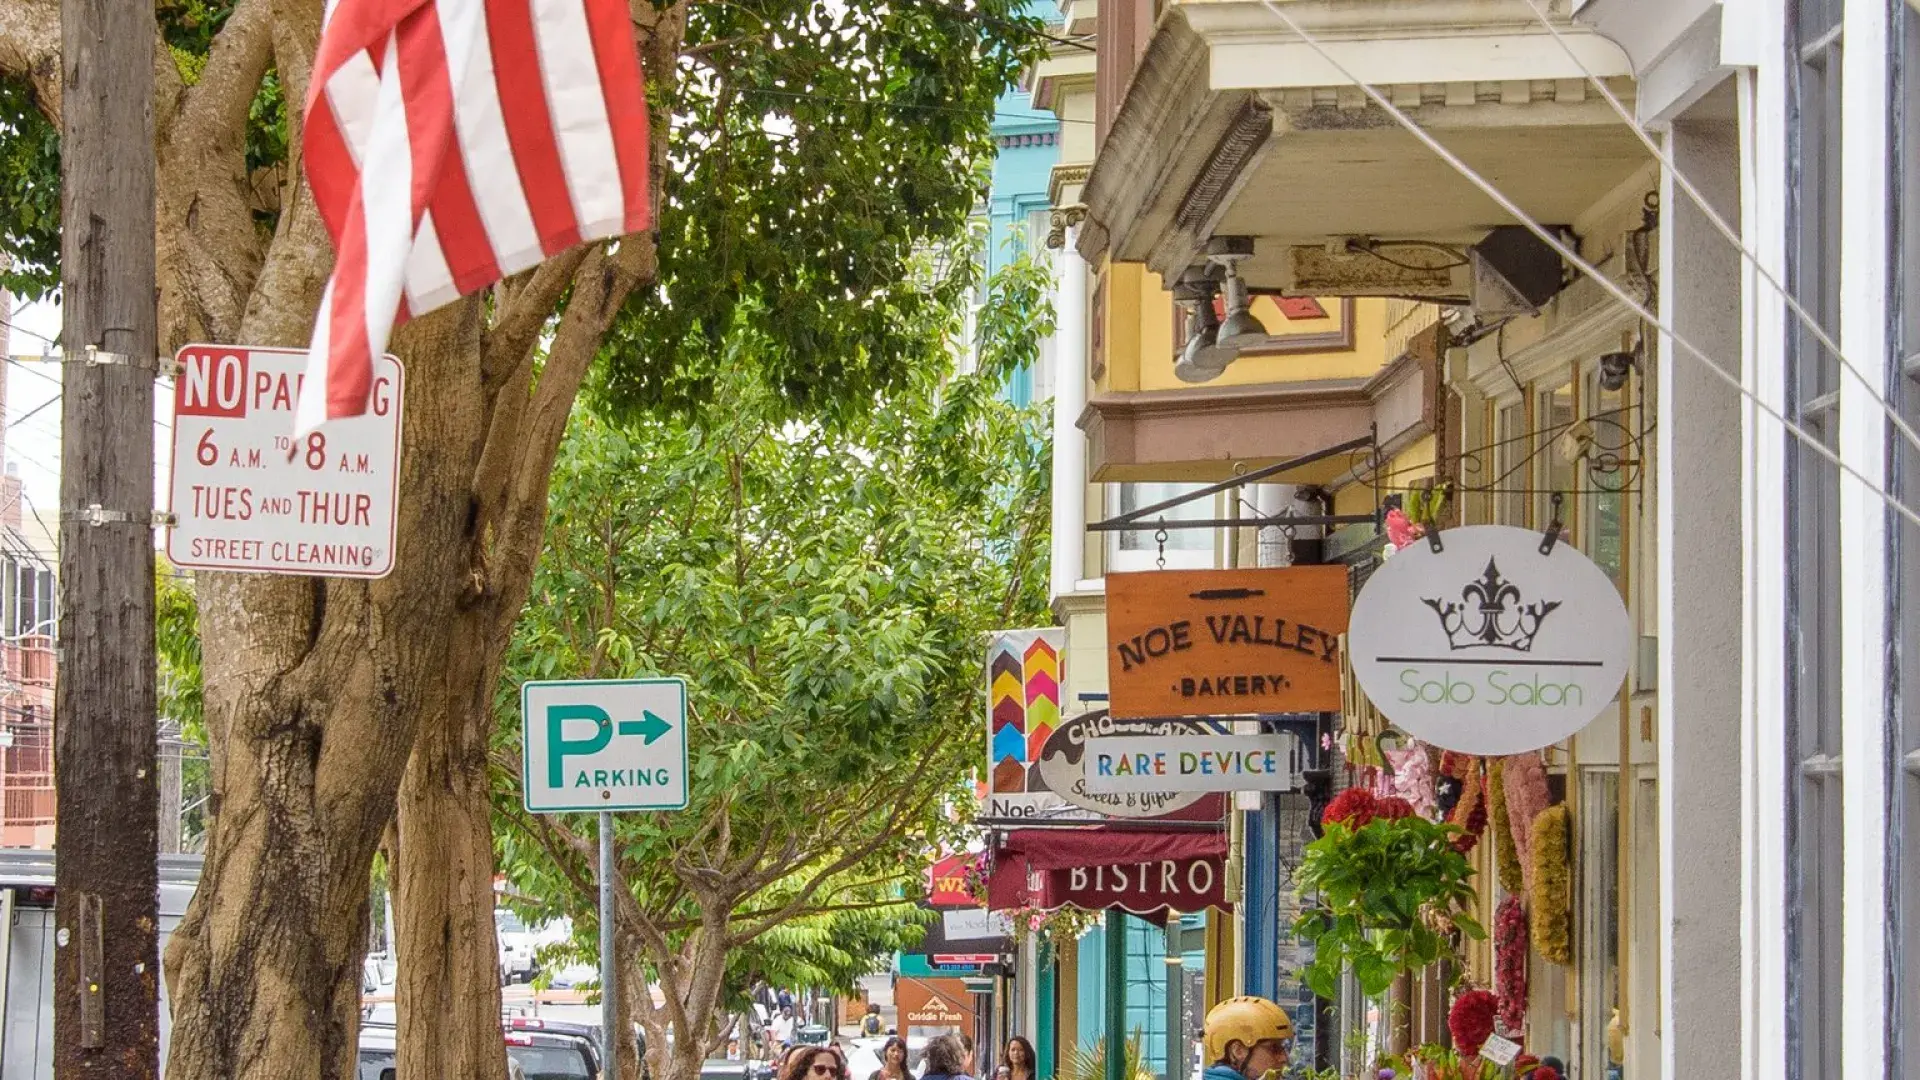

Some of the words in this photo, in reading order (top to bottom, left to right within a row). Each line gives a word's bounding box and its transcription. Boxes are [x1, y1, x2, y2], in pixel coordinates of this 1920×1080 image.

[184, 354, 242, 410] NO
[197, 427, 219, 466] 6
[229, 448, 267, 469] A.M.
[274, 436, 289, 451] TO
[306, 431, 326, 471] 8
[339, 453, 375, 474] A.M.
[192, 486, 253, 521] TUES
[260, 498, 292, 515] AND
[297, 491, 371, 527] THUR
[191, 538, 264, 561] STREET
[271, 542, 373, 567] CLEANING
[1117, 620, 1193, 672] NOE
[1205, 615, 1338, 663] VALLEY
[1181, 674, 1285, 697] BAKERY
[1397, 668, 1475, 705] Solo
[1487, 670, 1583, 707] Salon
[1097, 752, 1167, 776] RARE
[1179, 750, 1277, 776] DEVICE
[991, 799, 1036, 818] Noe
[1070, 859, 1213, 894] BISTRO
